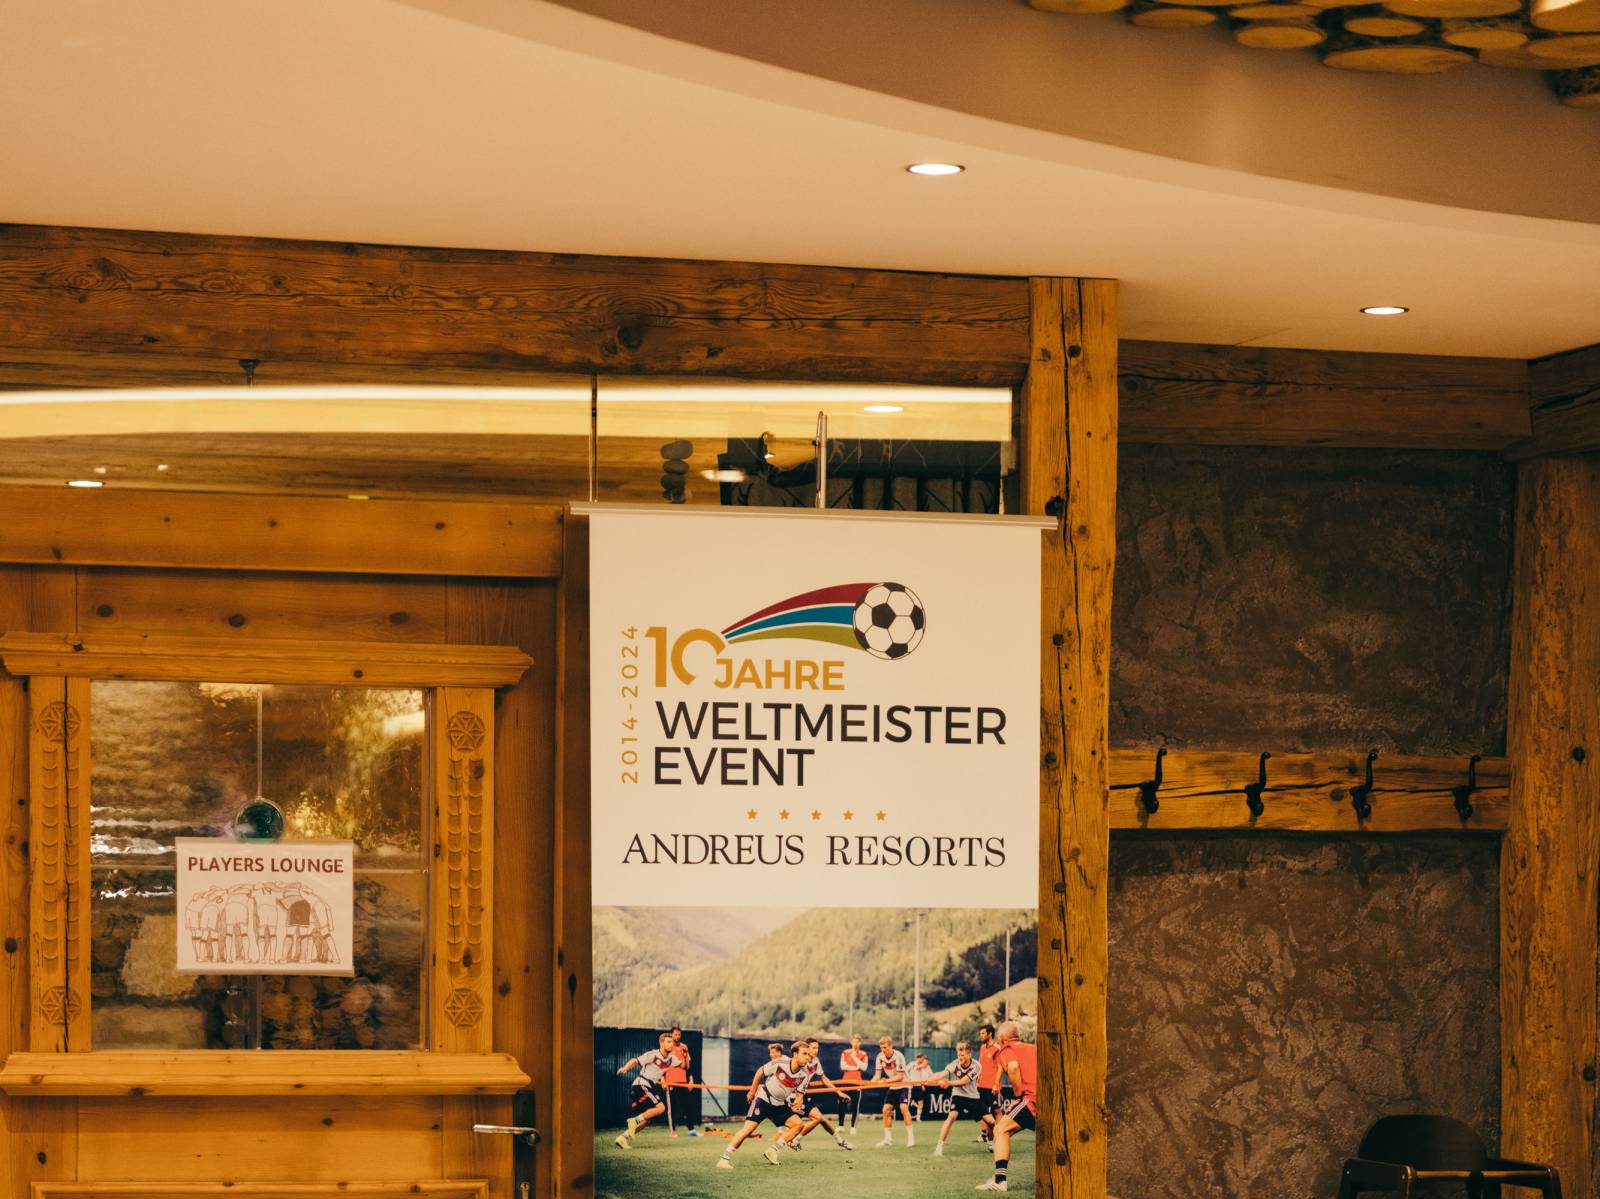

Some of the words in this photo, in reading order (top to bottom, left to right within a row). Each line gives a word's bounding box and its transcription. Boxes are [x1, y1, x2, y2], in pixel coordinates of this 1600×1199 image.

[644, 626, 727, 687] 10
[714, 659, 844, 690] JAHRE
[621, 625, 638, 784] 2014-2024
[655, 701, 1007, 745] WELTMEISTER
[654, 746, 815, 787] EVENT
[188, 856, 265, 872] PLAYERS
[271, 857, 344, 873] LOUNGE
[621, 833, 805, 866] ANDREUS
[825, 835, 1006, 868] RESORTS
[929, 1093, 950, 1114] Me
